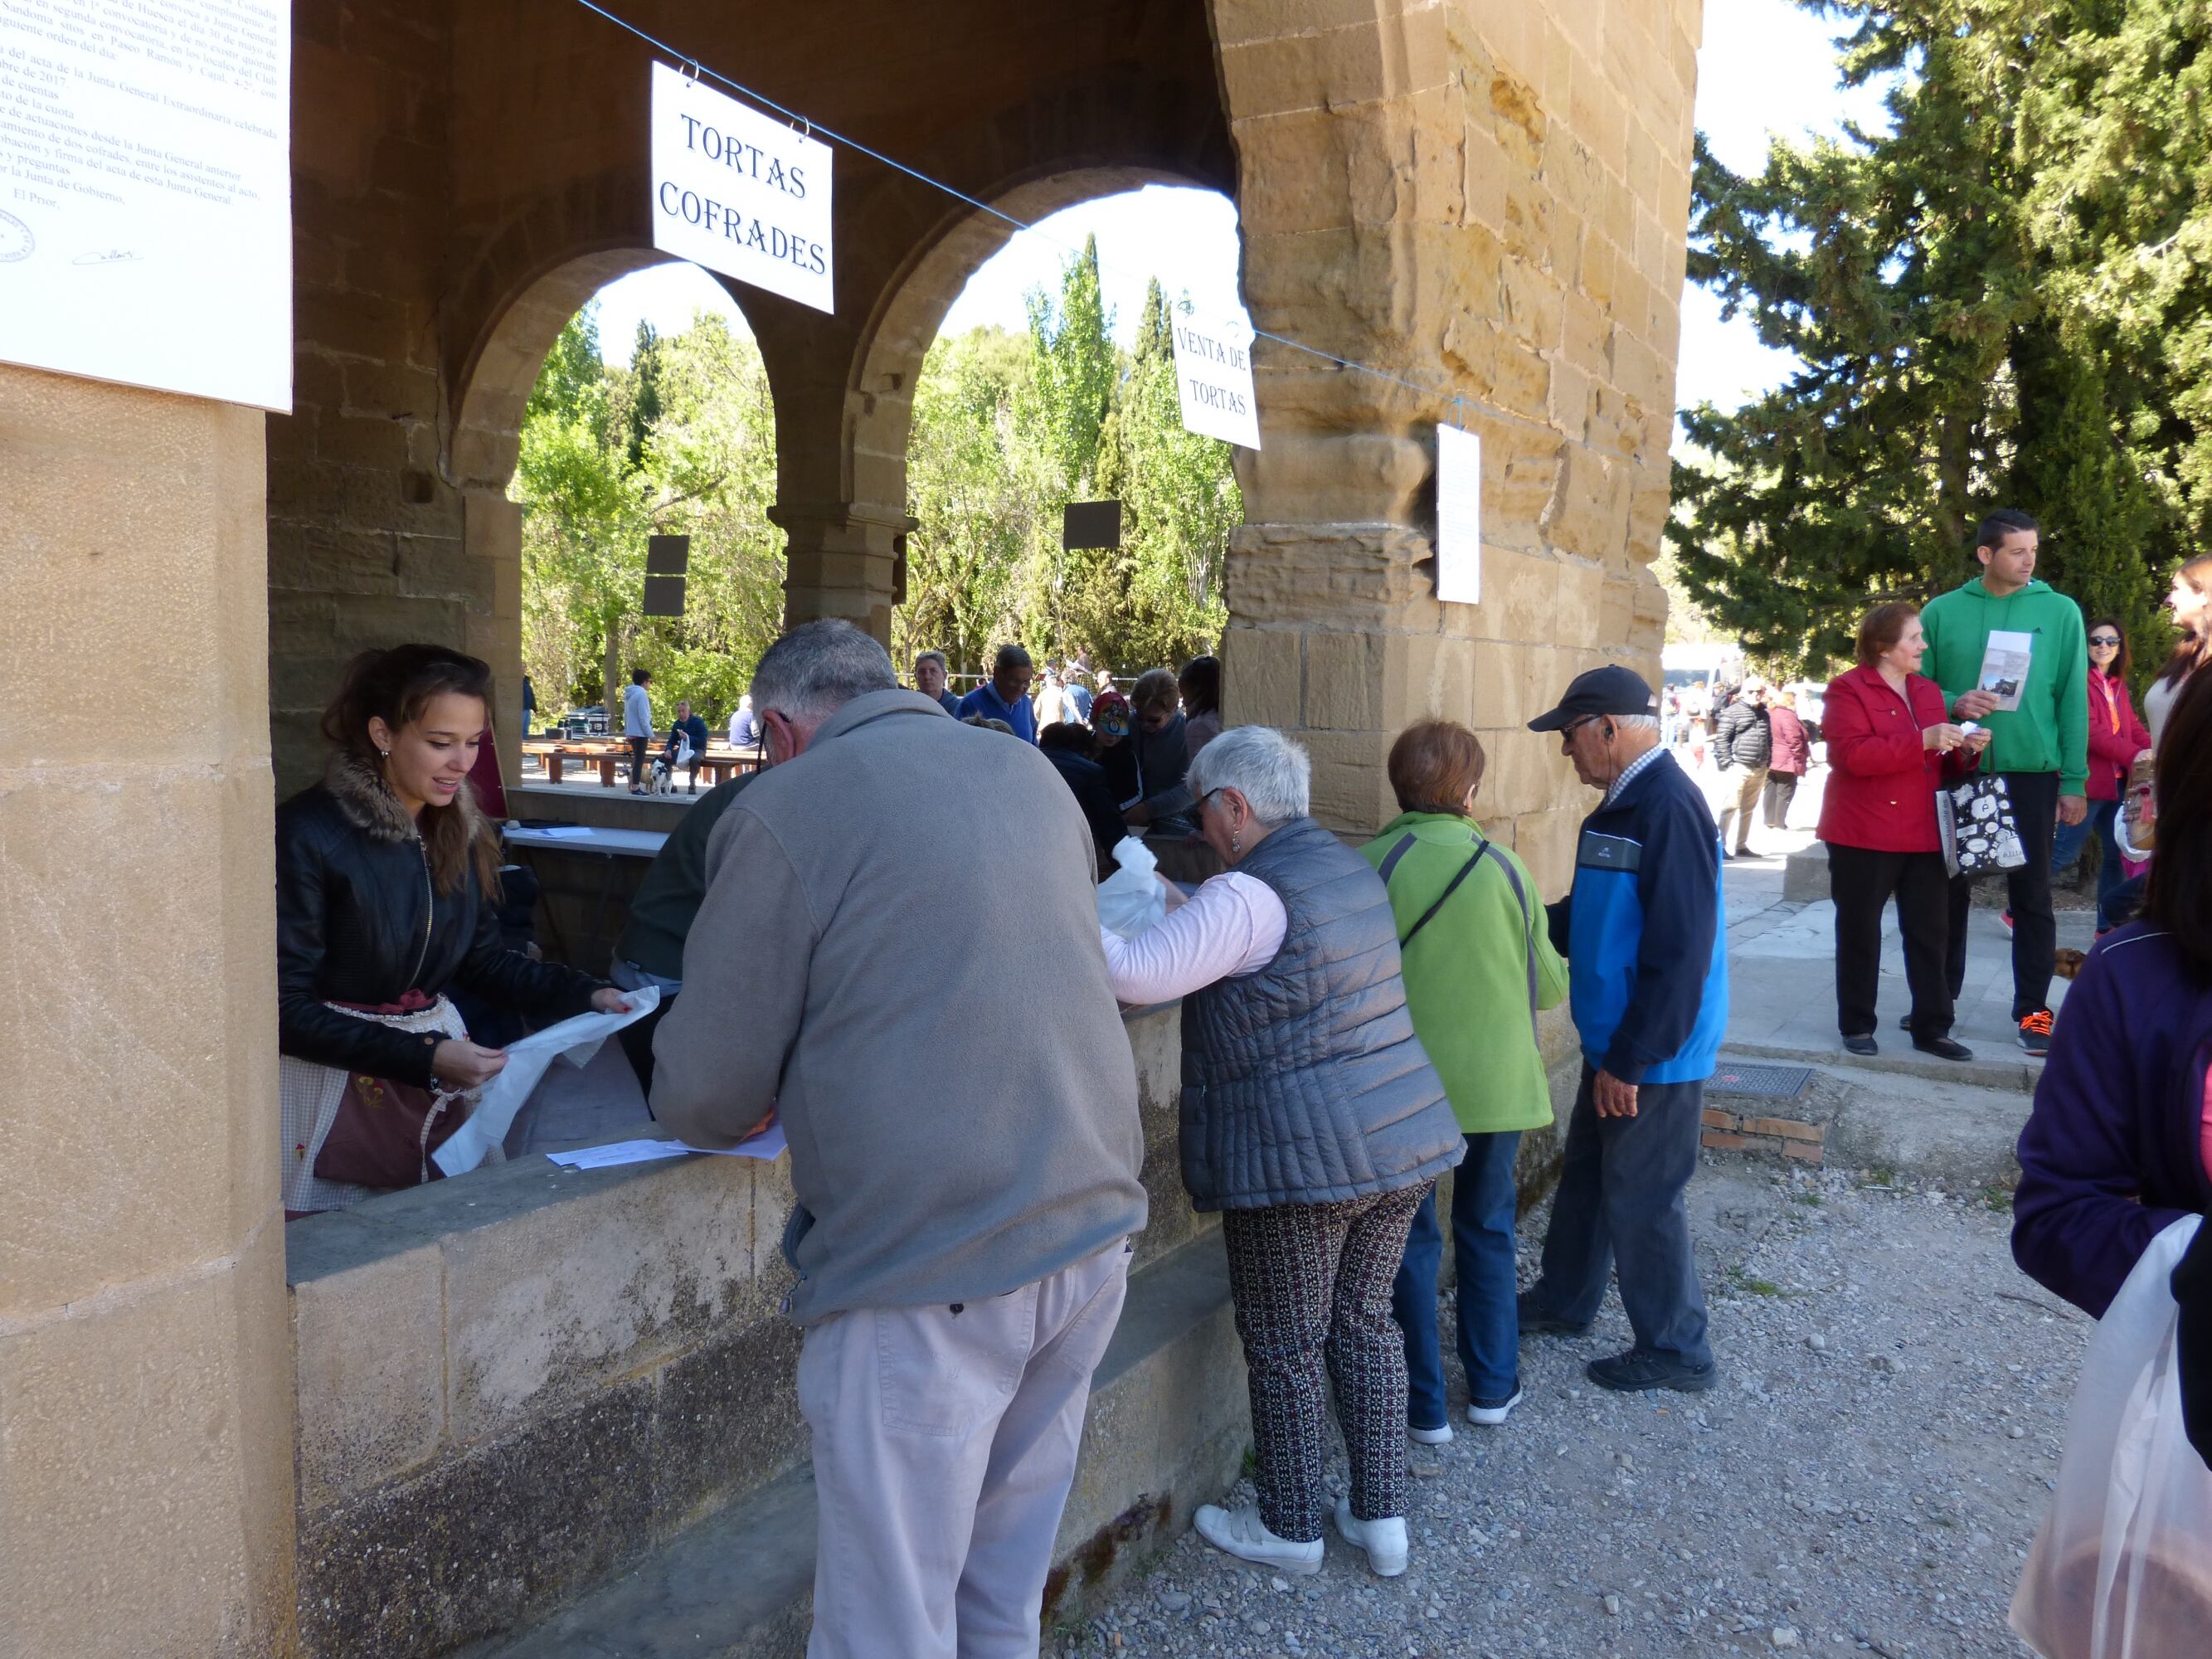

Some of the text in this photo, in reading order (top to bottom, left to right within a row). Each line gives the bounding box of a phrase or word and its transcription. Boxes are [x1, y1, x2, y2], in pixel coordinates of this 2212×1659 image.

[103, 7, 168, 36] convocatoria
[180, 32, 192, 44] de
[195, 39, 207, 48] no
[211, 45, 239, 61] existir
[139, 3, 174, 23] Huesca
[209, 28, 221, 40] 30
[224, 34, 236, 45] de
[238, 41, 263, 55] mayo
[266, 49, 277, 61] de
[160, 1, 277, 47] convoca a Junta General
[200, 2, 277, 34] cumplimiento al
[46, 32, 77, 47] orden
[80, 40, 95, 54] del
[53, 5, 96, 25] segunda
[171, 46, 182, 55] en
[186, 46, 200, 61] los
[203, 52, 236, 72] locales
[239, 66, 252, 79] del
[255, 71, 277, 87] Club
[60, 22, 85, 35] sitos
[91, 32, 104, 42] en
[110, 36, 140, 54] Paseo
[260, 90, 277, 100] con
[2, 75, 15, 87] de
[18, 82, 60, 100] cuentas
[8, 46, 25, 61] del
[30, 56, 52, 69] acta
[56, 61, 70, 74] de
[75, 66, 84, 79] la
[87, 71, 115, 88] Junta
[119, 82, 158, 102] General
[163, 94, 231, 125] Extraordinaria
[235, 120, 277, 139] celebrada
[23, 66, 36, 78] de
[16, 95, 28, 106] de
[32, 98, 42, 109] la
[46, 105, 75, 120] cuota
[0, 120, 45, 139] amiento
[48, 132, 61, 144] de
[64, 137, 83, 149] dos
[135, 159, 160, 172] entre
[163, 163, 178, 177] los
[179, 172, 226, 190] asistentes
[227, 183, 236, 193] al
[9, 106, 22, 119] de
[25, 113, 88, 137] actuaciones
[91, 130, 120, 147] desde
[124, 139, 133, 150] la
[136, 143, 162, 158] Junta
[165, 152, 202, 171] General
[205, 165, 241, 181] anterior
[17, 155, 71, 175] preguntas
[680, 113, 806, 198] TORTAS
[12, 165, 22, 178] la
[24, 169, 54, 186] Junta
[57, 178, 70, 190] de
[13, 187, 26, 200] El
[55, 148, 84, 165] firma
[86, 157, 103, 170] del
[105, 165, 127, 177] acta
[129, 168, 142, 181] de
[144, 176, 163, 187] esta
[166, 178, 192, 195] Junta
[659, 181, 826, 275] COFRADES
[1177, 327, 1247, 371] VENTA DE
[1189, 379, 1247, 416] TORTAS
